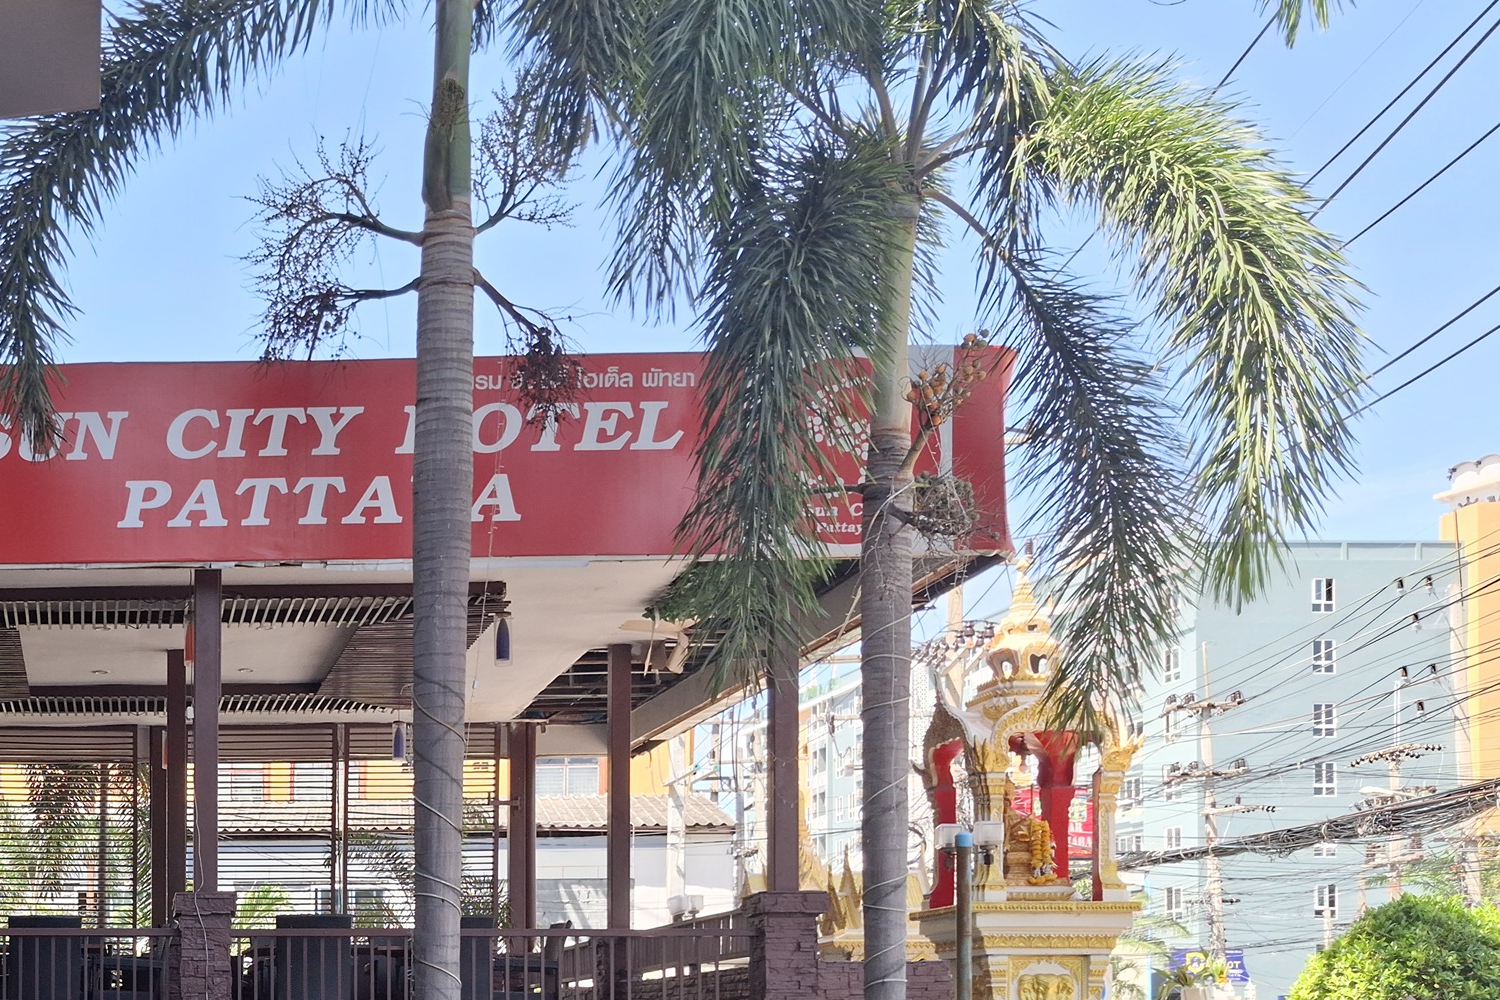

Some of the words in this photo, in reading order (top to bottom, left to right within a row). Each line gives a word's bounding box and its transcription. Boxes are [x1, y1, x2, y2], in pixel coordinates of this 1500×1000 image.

[166, 406, 365, 460] CITY
[117, 474, 522, 529] PATTAA
[815, 521, 863, 535] Pattay
